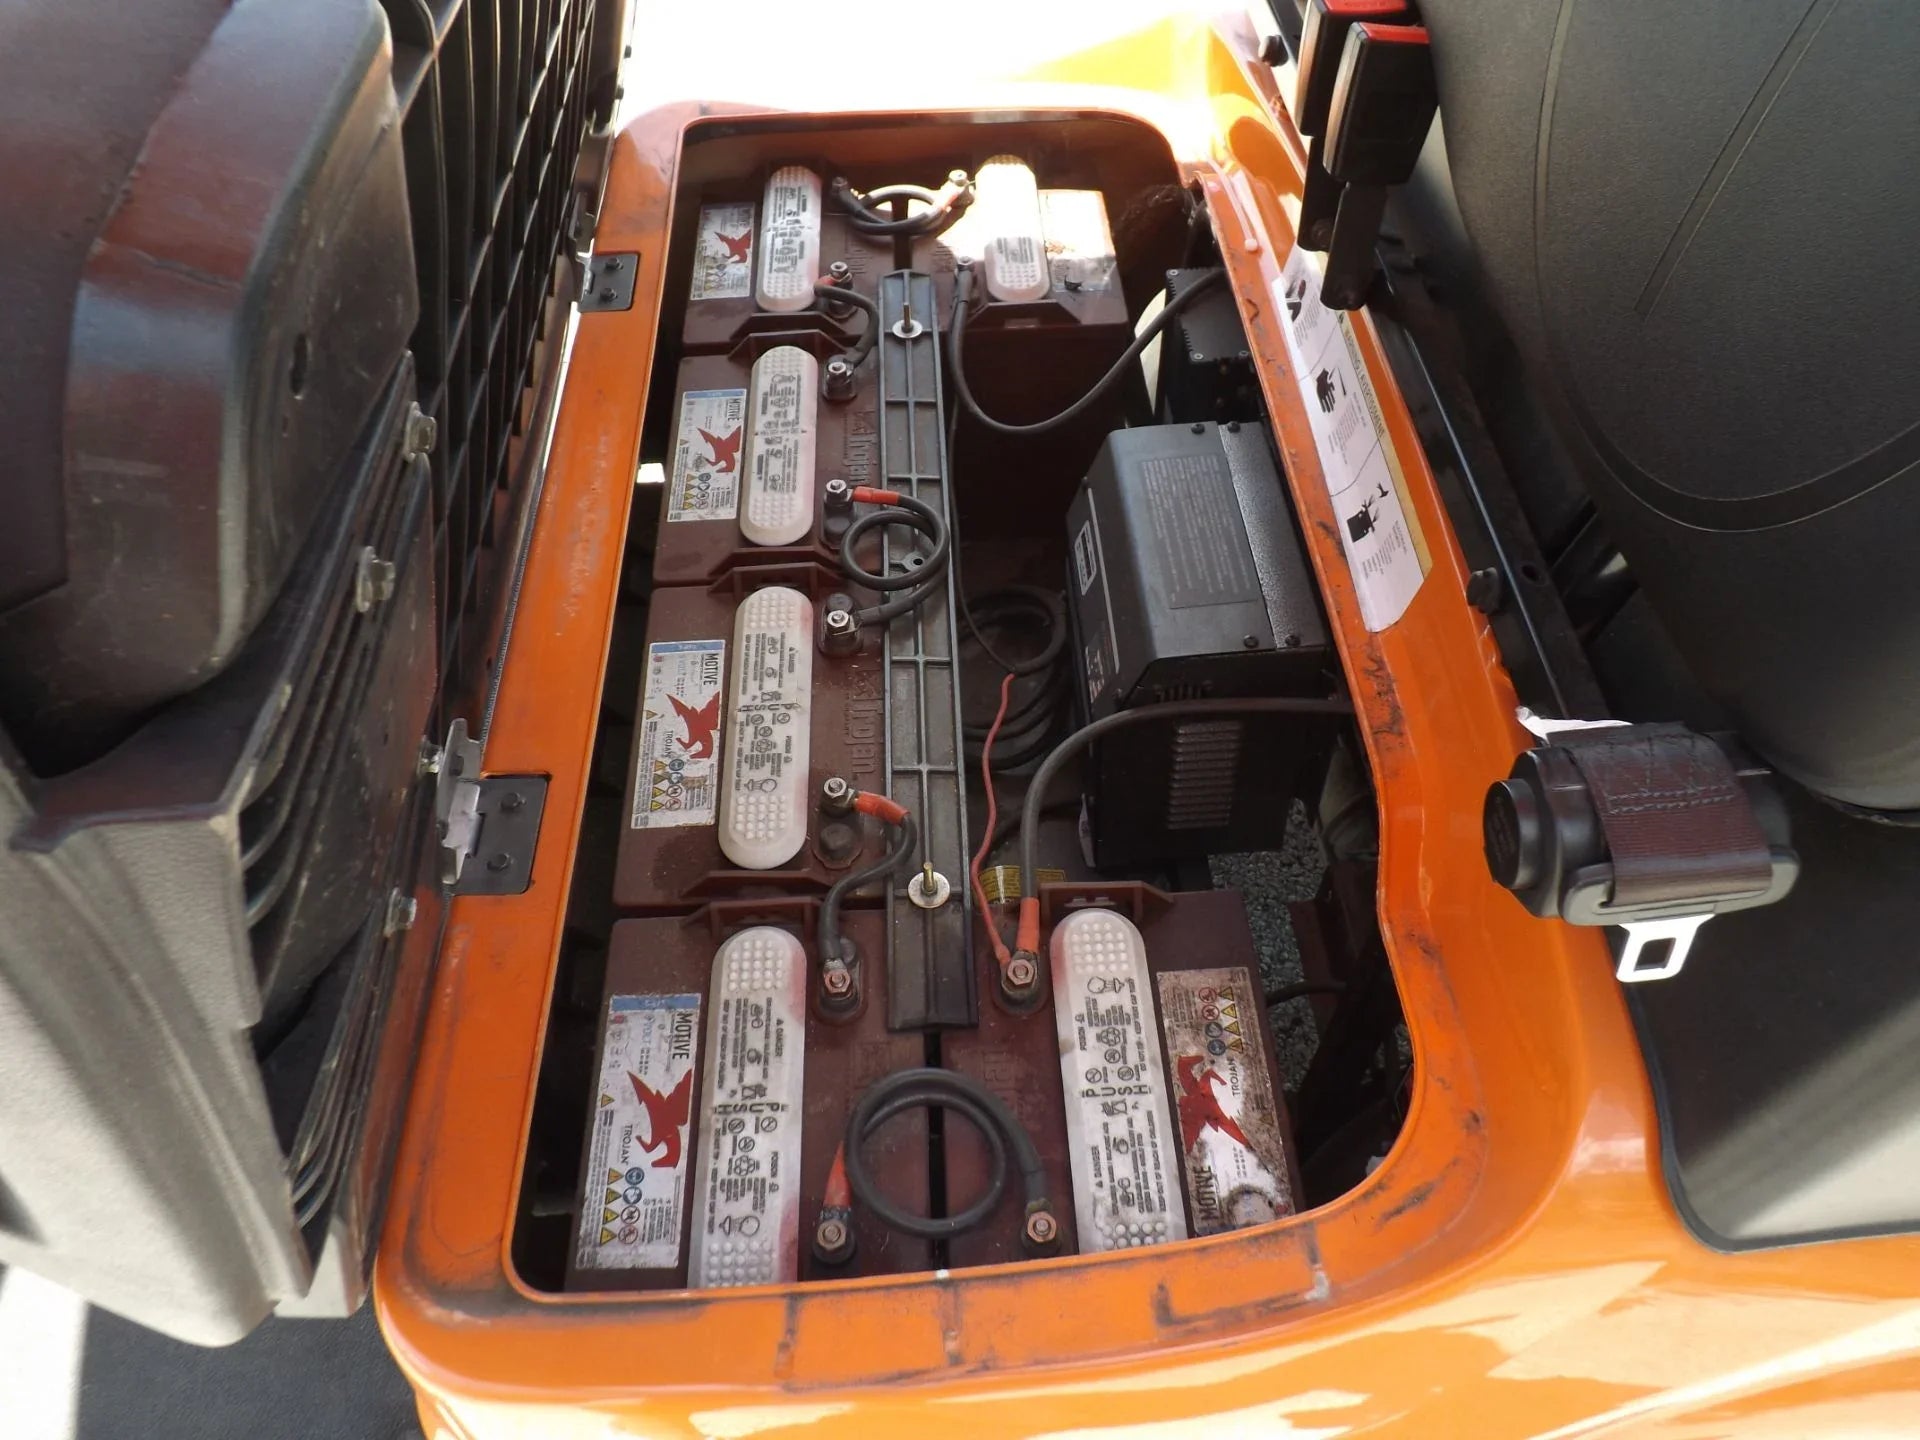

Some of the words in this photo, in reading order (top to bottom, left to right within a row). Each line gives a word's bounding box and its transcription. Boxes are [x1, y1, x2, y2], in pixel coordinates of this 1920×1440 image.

[727, 398, 742, 422] MOTIVE
[702, 652, 720, 686] MOTIVE
[741, 704, 792, 713] PUSH
[663, 729, 674, 757] TROJAN
[672, 1010, 692, 1061] MOTIVE
[774, 1027, 783, 1057] DANGER
[1077, 1026, 1087, 1050] POISON
[1085, 1084, 1147, 1097] PUSH
[1227, 1059, 1240, 1095] TROJAN
[717, 1102, 780, 1114] PUSH
[620, 1124, 632, 1164] TROJAN
[770, 1151, 778, 1177] POISON
[1091, 1145, 1102, 1177] DANGER
[1193, 1165, 1218, 1219] MOTIVE
